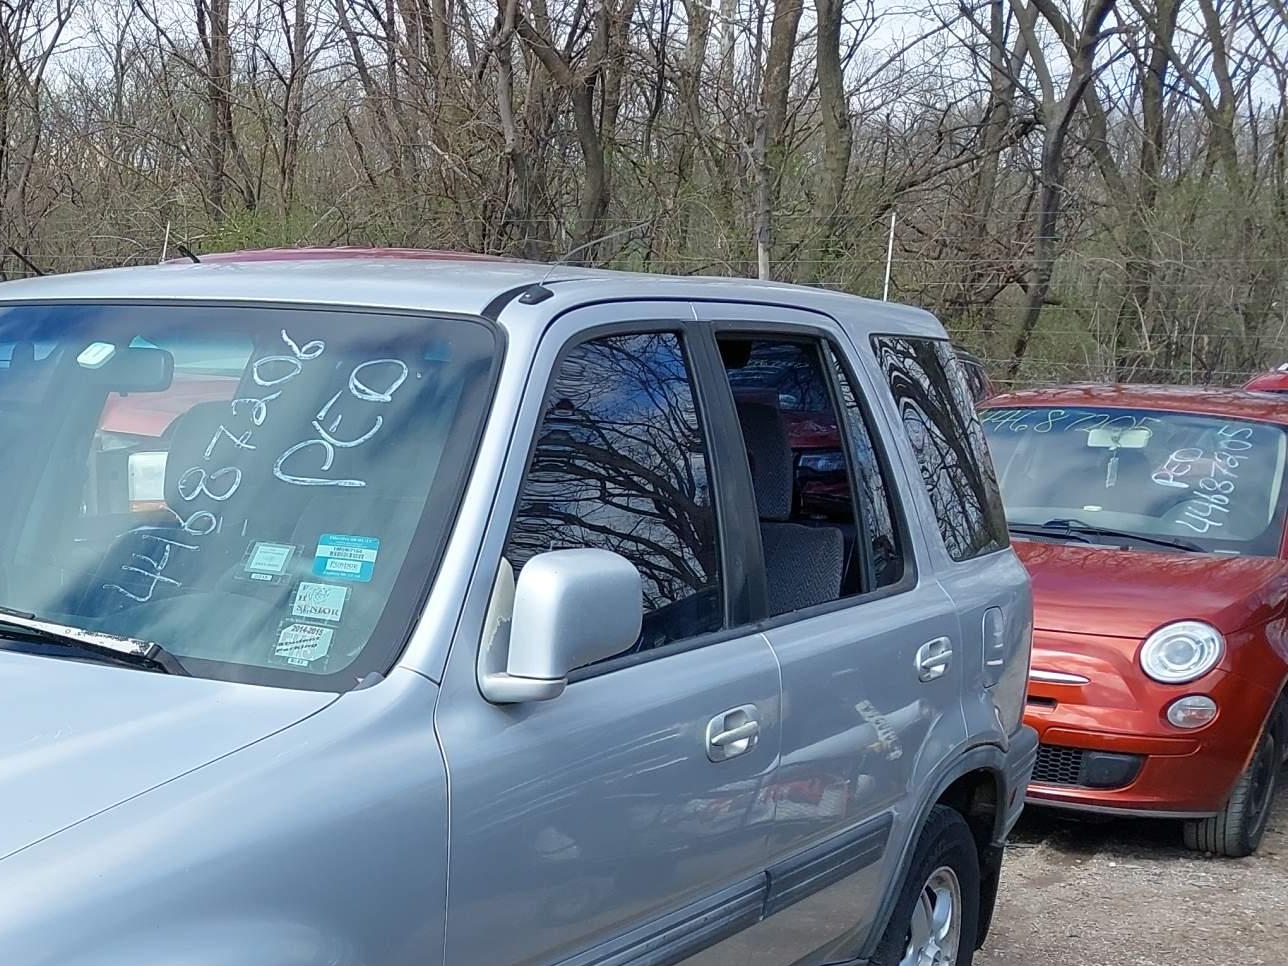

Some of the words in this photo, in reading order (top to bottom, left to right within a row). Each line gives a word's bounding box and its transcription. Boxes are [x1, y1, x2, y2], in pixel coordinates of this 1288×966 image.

[103, 329, 326, 602] 44687206
[1175, 424, 1253, 533] 44687205
[295, 604, 340, 617] SENIOR
